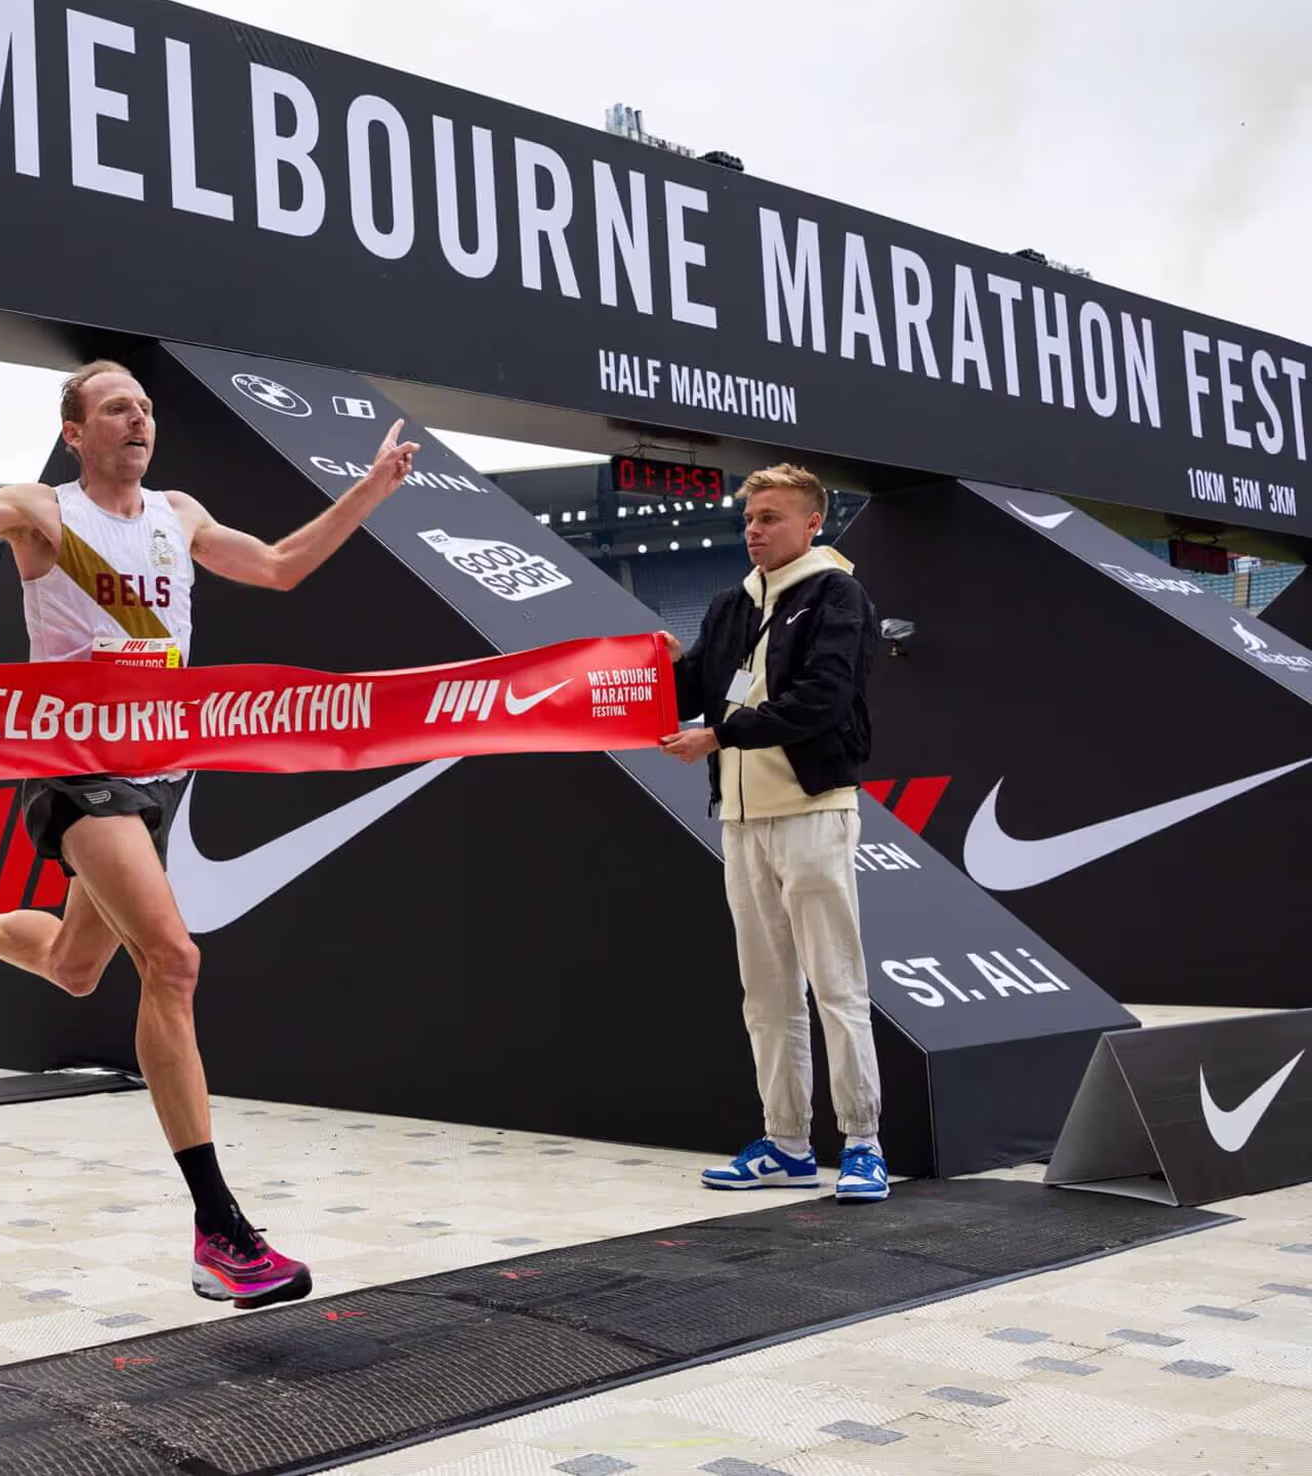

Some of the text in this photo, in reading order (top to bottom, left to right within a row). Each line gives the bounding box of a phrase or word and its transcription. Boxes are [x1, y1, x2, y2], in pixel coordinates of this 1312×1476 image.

[759, 207, 1162, 429] MARATHON
[1183, 329, 1306, 461] FEST
[599, 349, 797, 425] HALF MARATHON
[309, 456, 489, 493] GAMIN.
[1187, 467, 1297, 517] 10KM 5KM 3KM
[452, 545, 527, 575] GOOD
[95, 573, 171, 609] BELS
[482, 561, 563, 596] SPORT
[587, 667, 658, 686] MELBOURNE
[591, 685, 652, 704] MARATHON
[198, 681, 374, 738] MARATHON
[592, 704, 627, 718] FESTIVAL
[881, 956, 987, 1008] ST.
